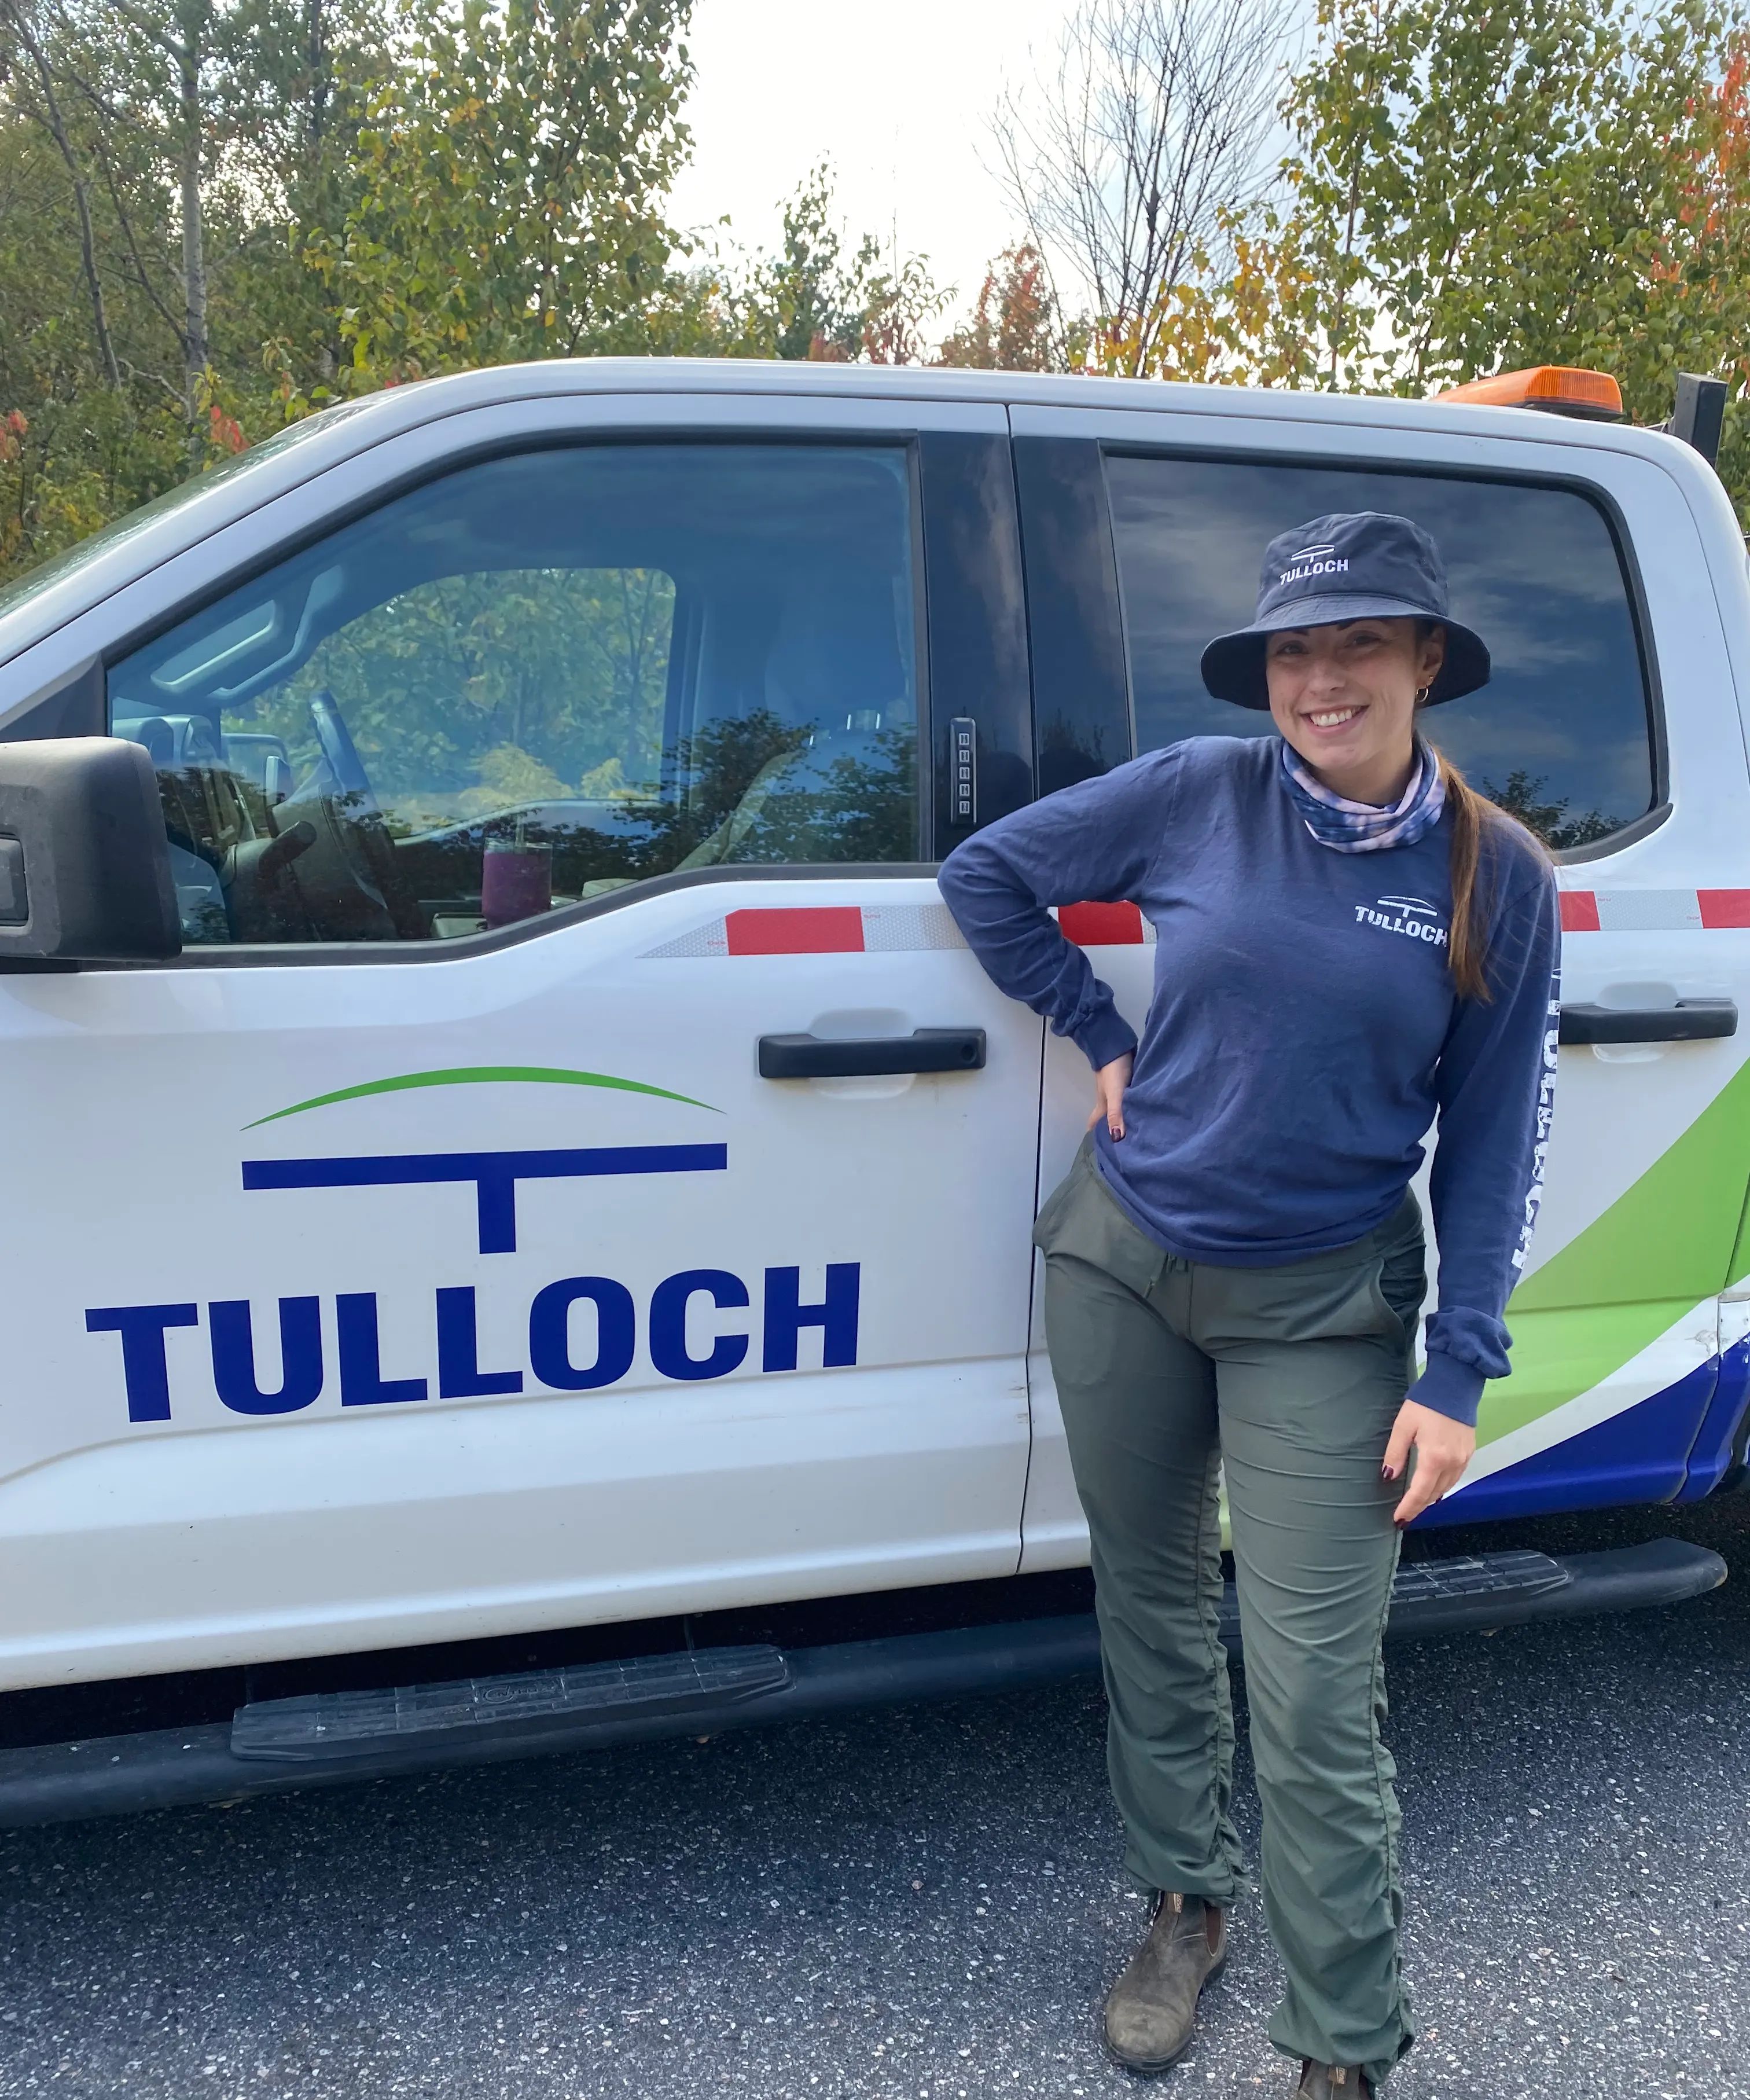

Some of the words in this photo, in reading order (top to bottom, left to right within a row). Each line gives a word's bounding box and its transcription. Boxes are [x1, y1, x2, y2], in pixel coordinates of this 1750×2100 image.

[1280, 559, 1349, 585] TULLOCH
[1355, 905, 1447, 948] TULLOCH
[85, 1262, 861, 1422] TULLOCH
